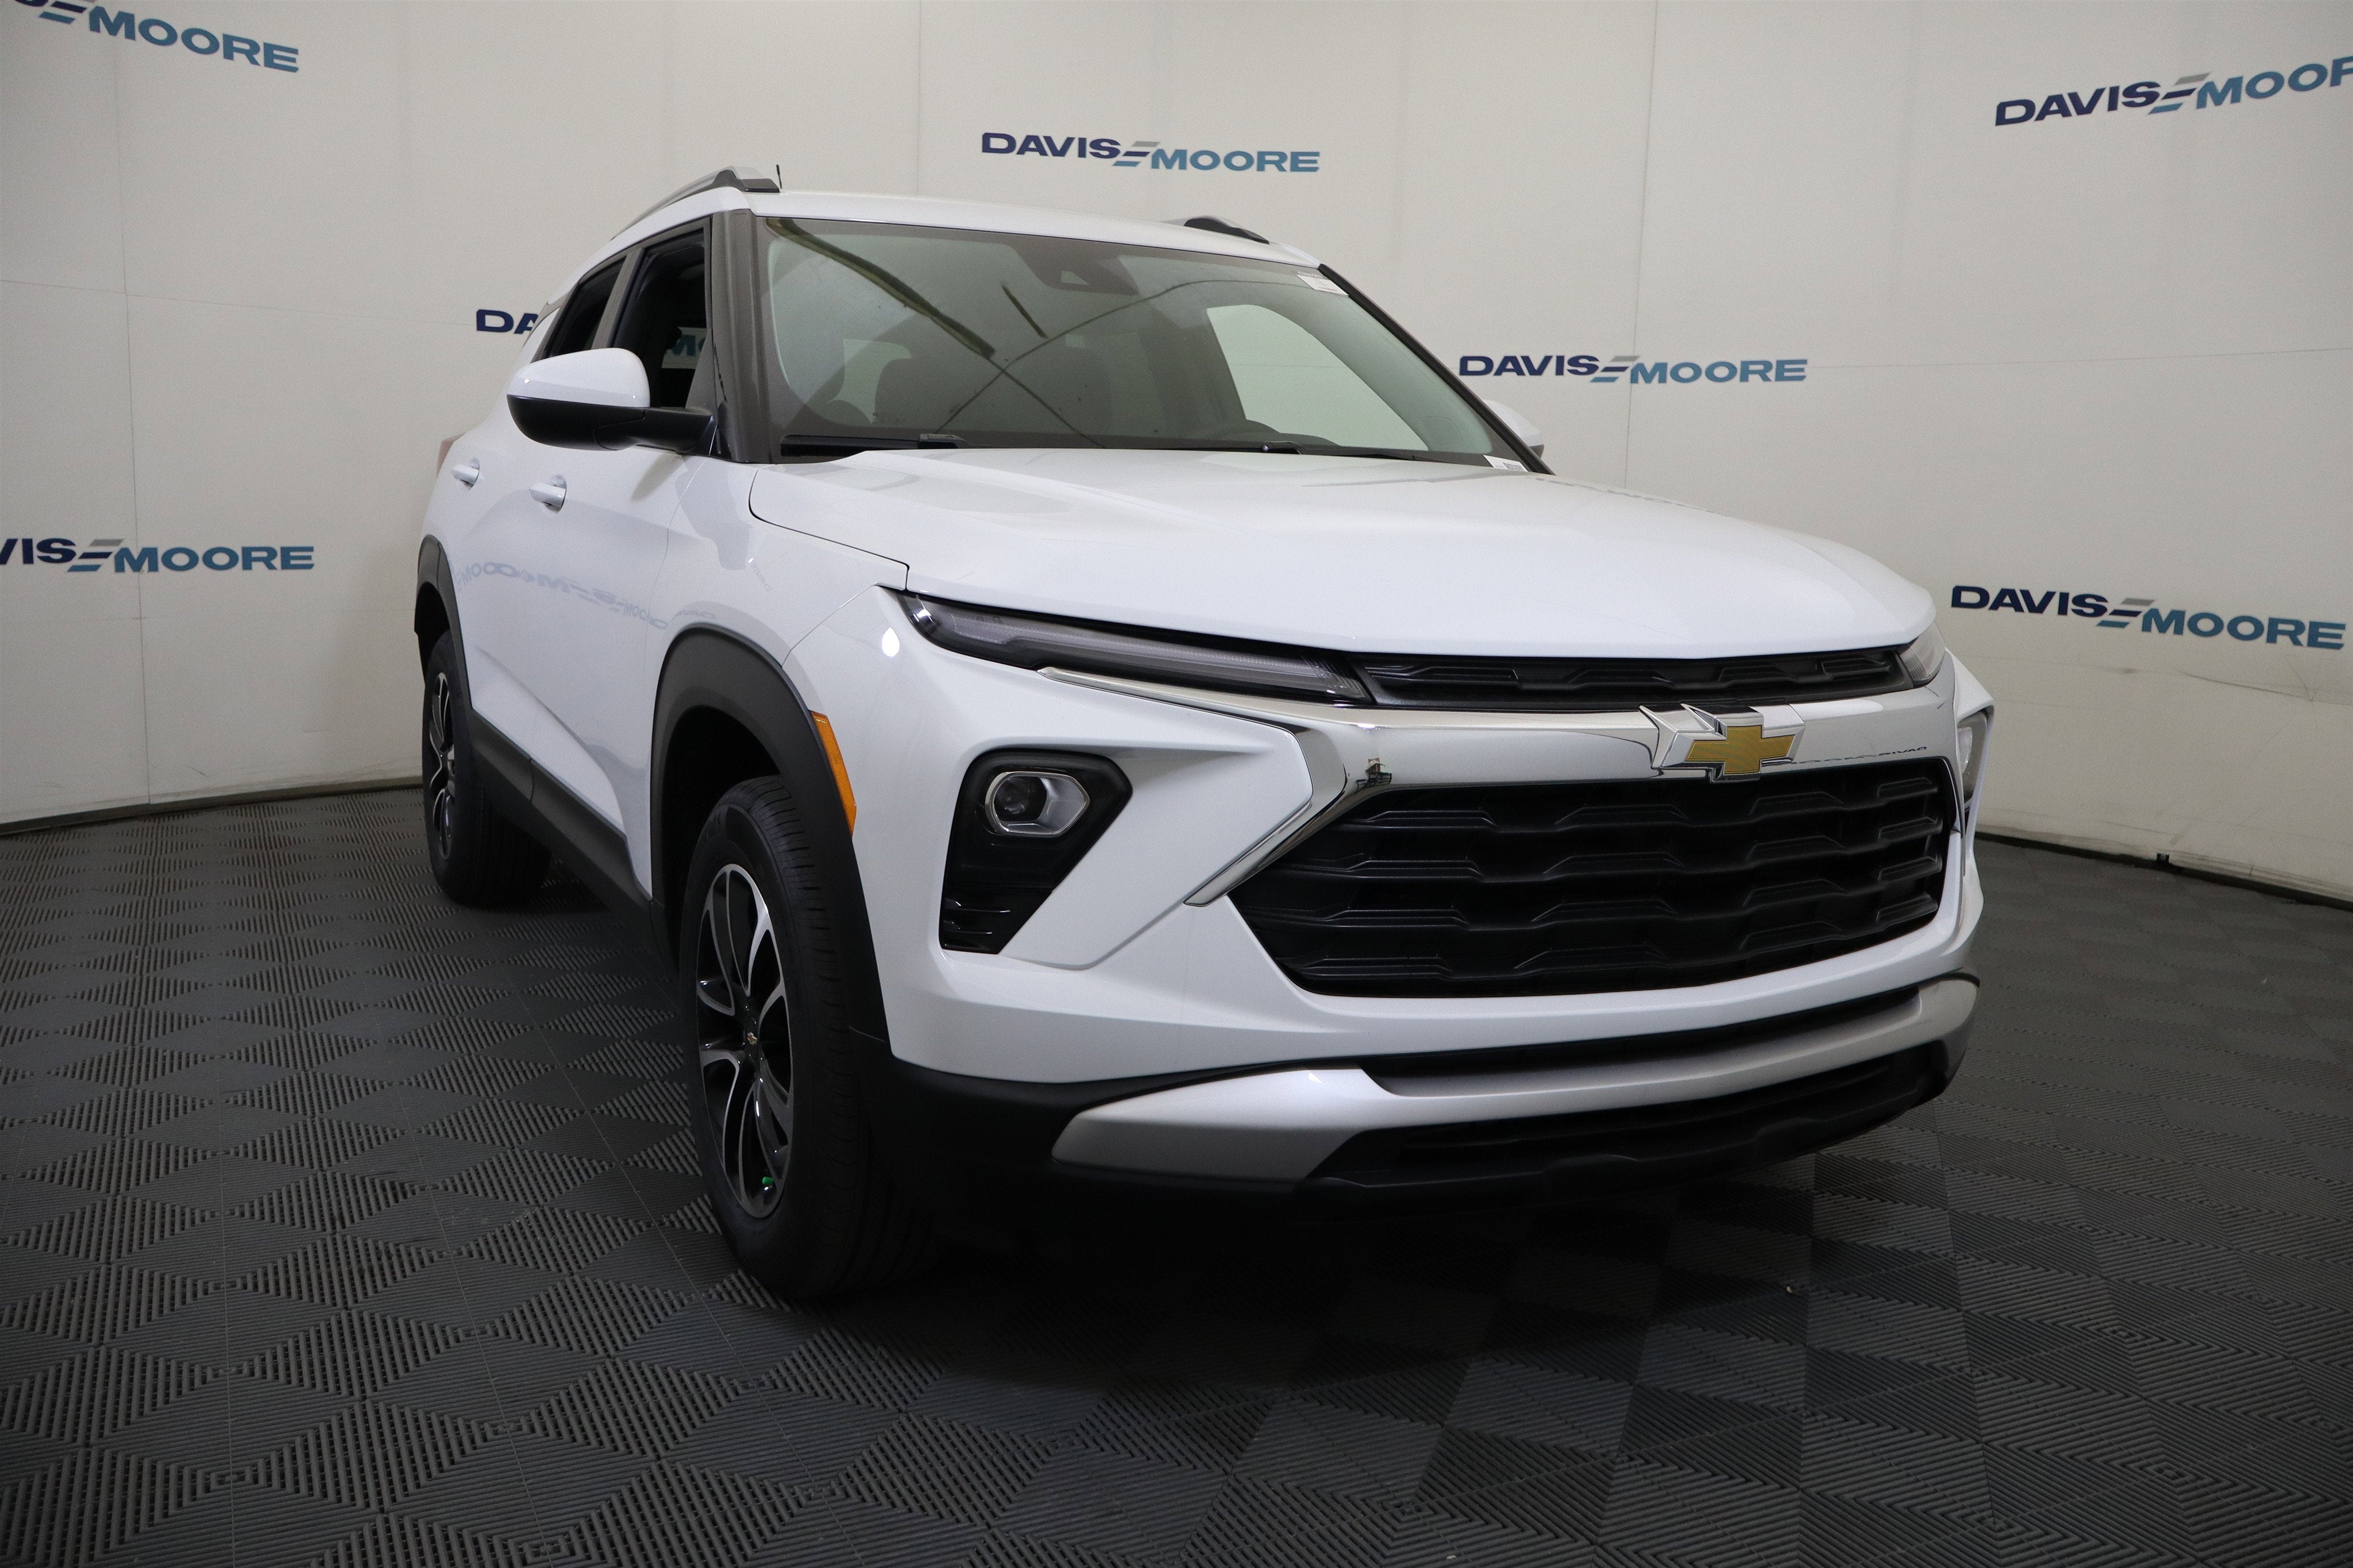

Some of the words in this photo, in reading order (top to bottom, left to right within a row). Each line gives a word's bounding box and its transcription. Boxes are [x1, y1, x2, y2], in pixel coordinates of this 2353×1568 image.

[88, 5, 298, 73] MOORE
[1995, 81, 2161, 126] DAVIS
[981, 133, 1121, 159] DAVIS
[1151, 149, 1320, 172] MOORE
[1459, 355, 1599, 376] DAVIS
[1630, 360, 1807, 384] MOORE
[114, 546, 314, 573] MOORE
[1951, 585, 2108, 618] DAVIS
[2141, 608, 2346, 650] MOORE
